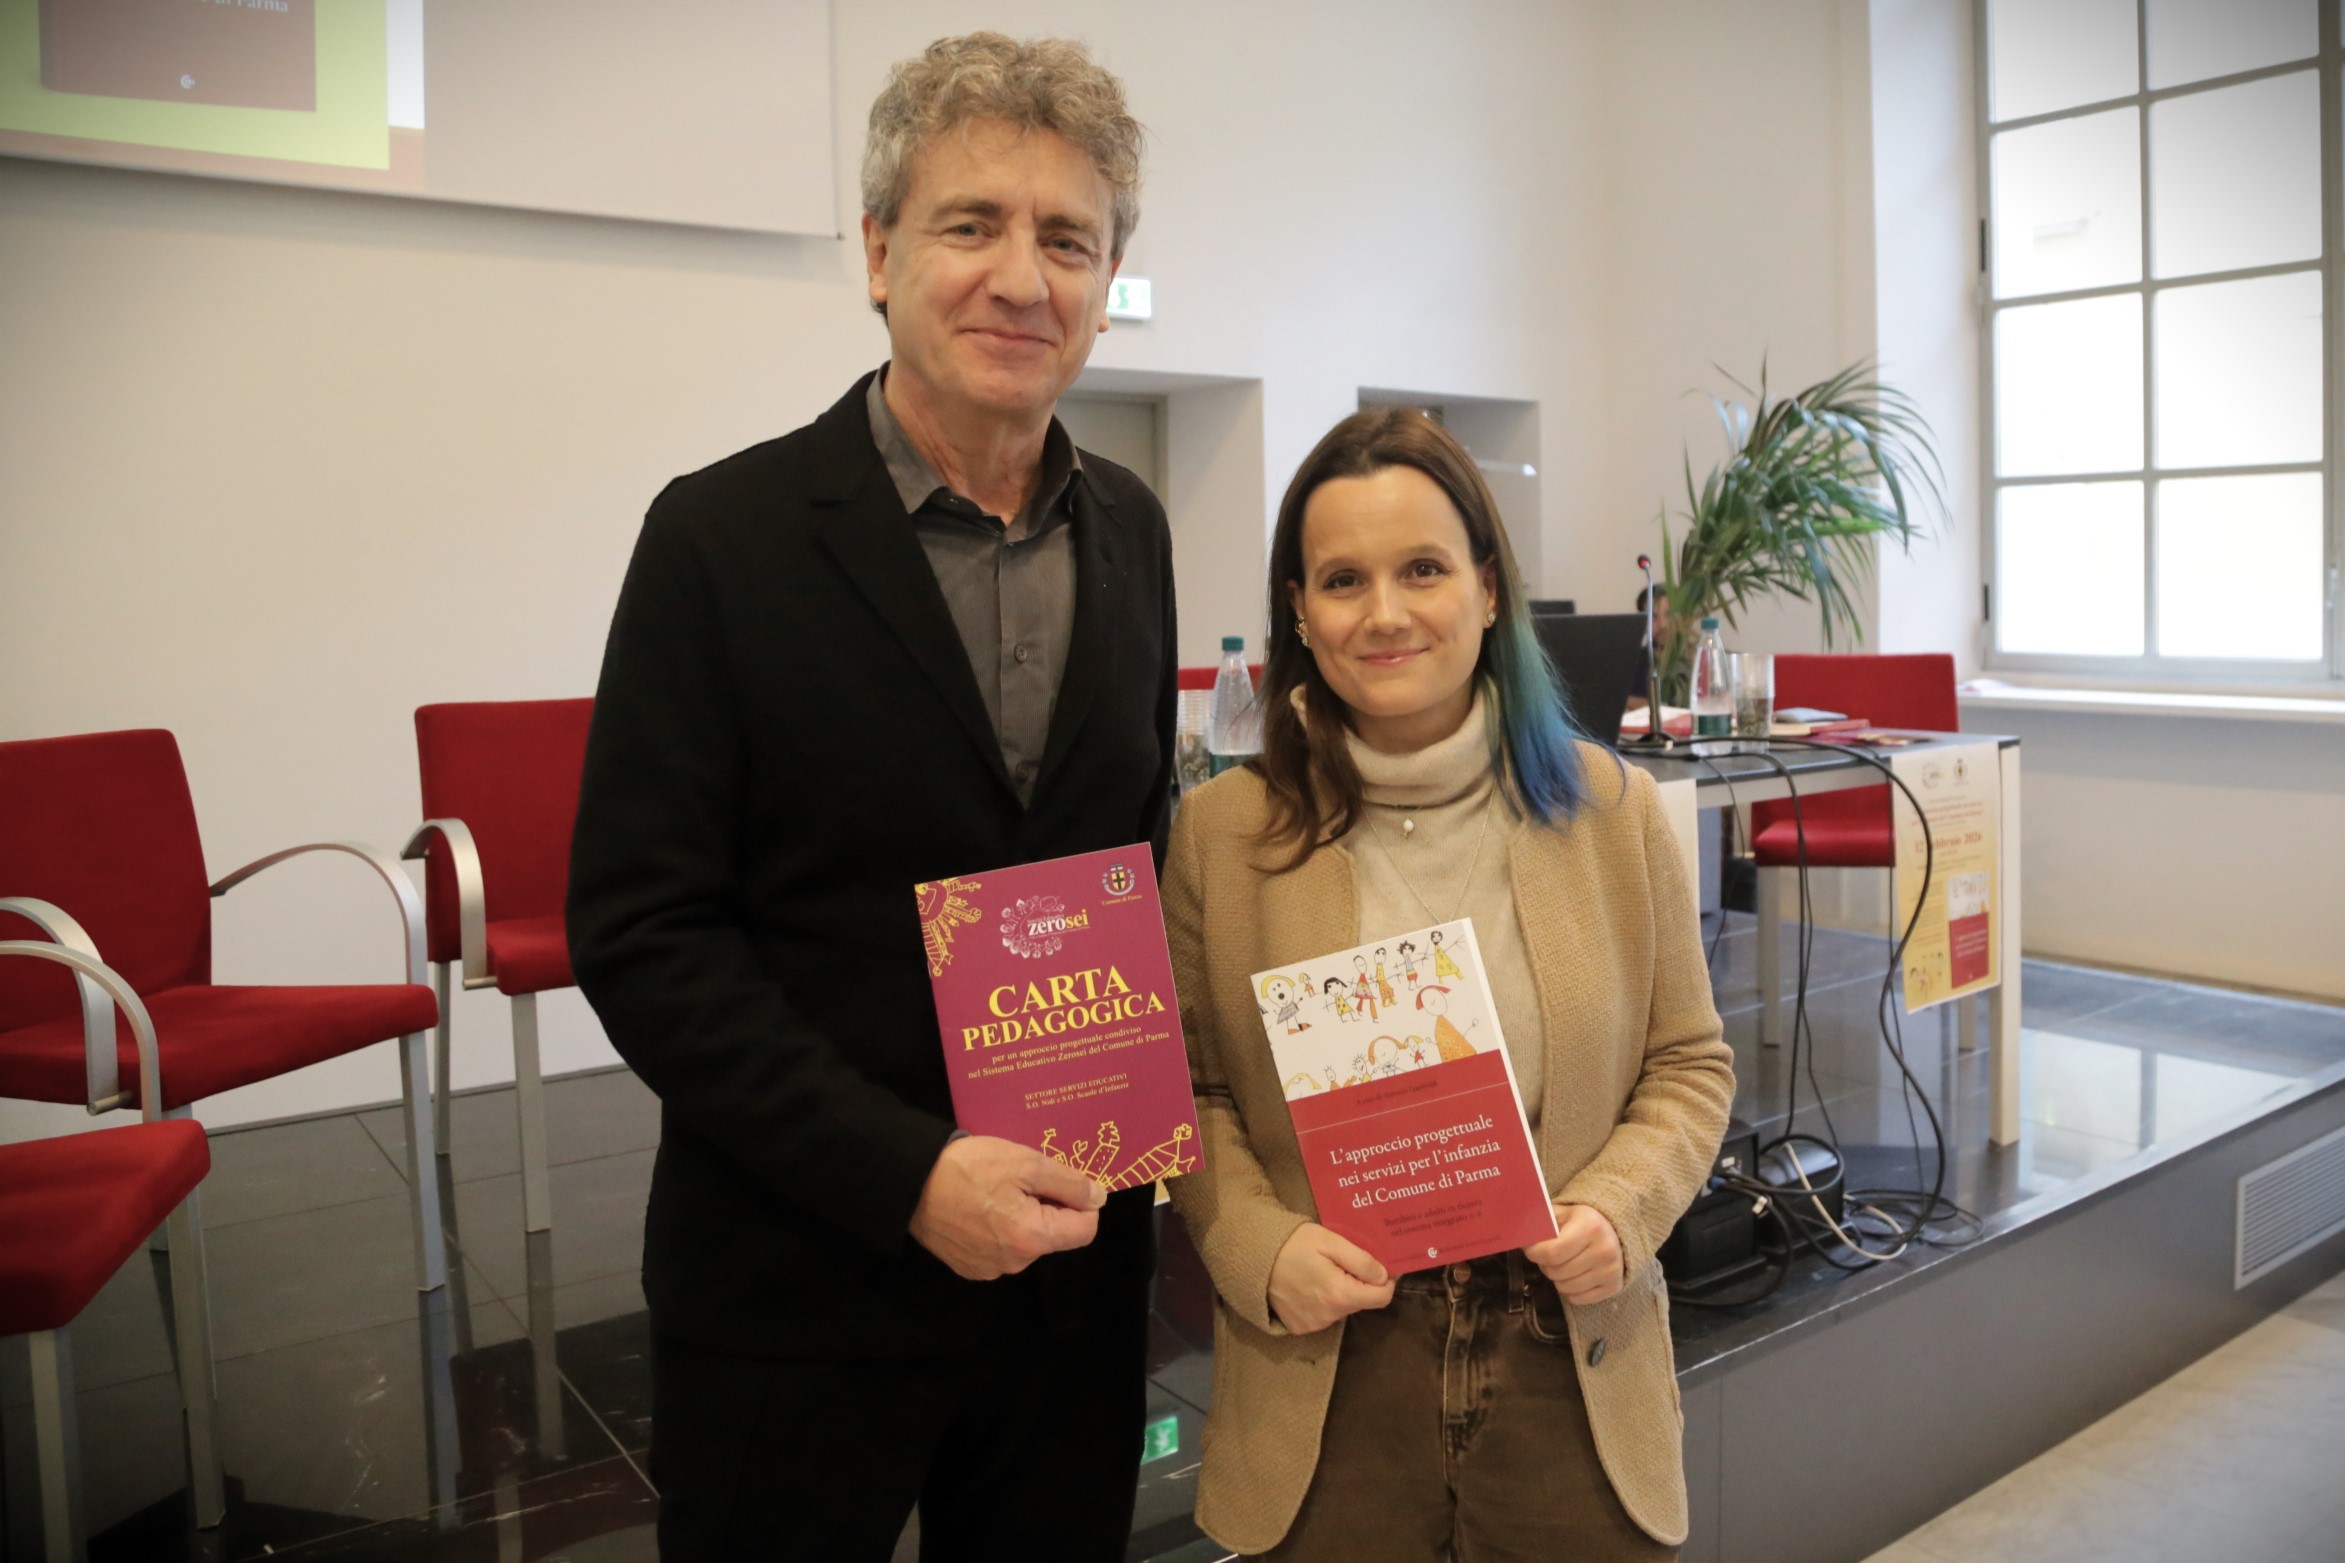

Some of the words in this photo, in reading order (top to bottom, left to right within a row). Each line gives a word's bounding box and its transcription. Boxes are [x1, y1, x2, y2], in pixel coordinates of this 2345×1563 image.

[1028, 908, 1089, 936] zerosei
[988, 965, 1132, 1018] CARTA
[961, 991, 1166, 1051] PEDAGOGICA
[968, 1070, 980, 1079] nel
[983, 1064, 1014, 1076] Sistema
[1016, 1055, 1056, 1070] Educativo
[1058, 1048, 1088, 1062] Zerosei
[1089, 1046, 1101, 1055] del
[1102, 1039, 1134, 1052] Comune
[1136, 1036, 1144, 1044] di
[1146, 1031, 1170, 1043] Parma
[992, 1054, 1005, 1064] per
[1008, 1052, 1018, 1060] un
[1020, 1043, 1058, 1060] approccio
[1060, 1034, 1103, 1052] progettuale
[1105, 1026, 1142, 1040] condiviso
[1024, 1088, 1058, 1101] SETTORE
[1059, 1082, 1088, 1094] SERVIZI
[1089, 1072, 1128, 1088] EDUCATIVI
[1042, 1098, 1056, 1107] Nidi
[1077, 1088, 1098, 1099] Scuole
[1330, 1136, 1412, 1165] L'approccio
[1414, 1114, 1494, 1148] progettuale
[1338, 1174, 1360, 1188] nei
[1362, 1160, 1406, 1182] servizi
[1408, 1156, 1432, 1176] per
[1432, 1139, 1501, 1166] l'infanzia
[1352, 1191, 1374, 1209] del
[1375, 1179, 1436, 1203] Comune
[1438, 1173, 1453, 1189] di
[1454, 1165, 1501, 1185] Parma
